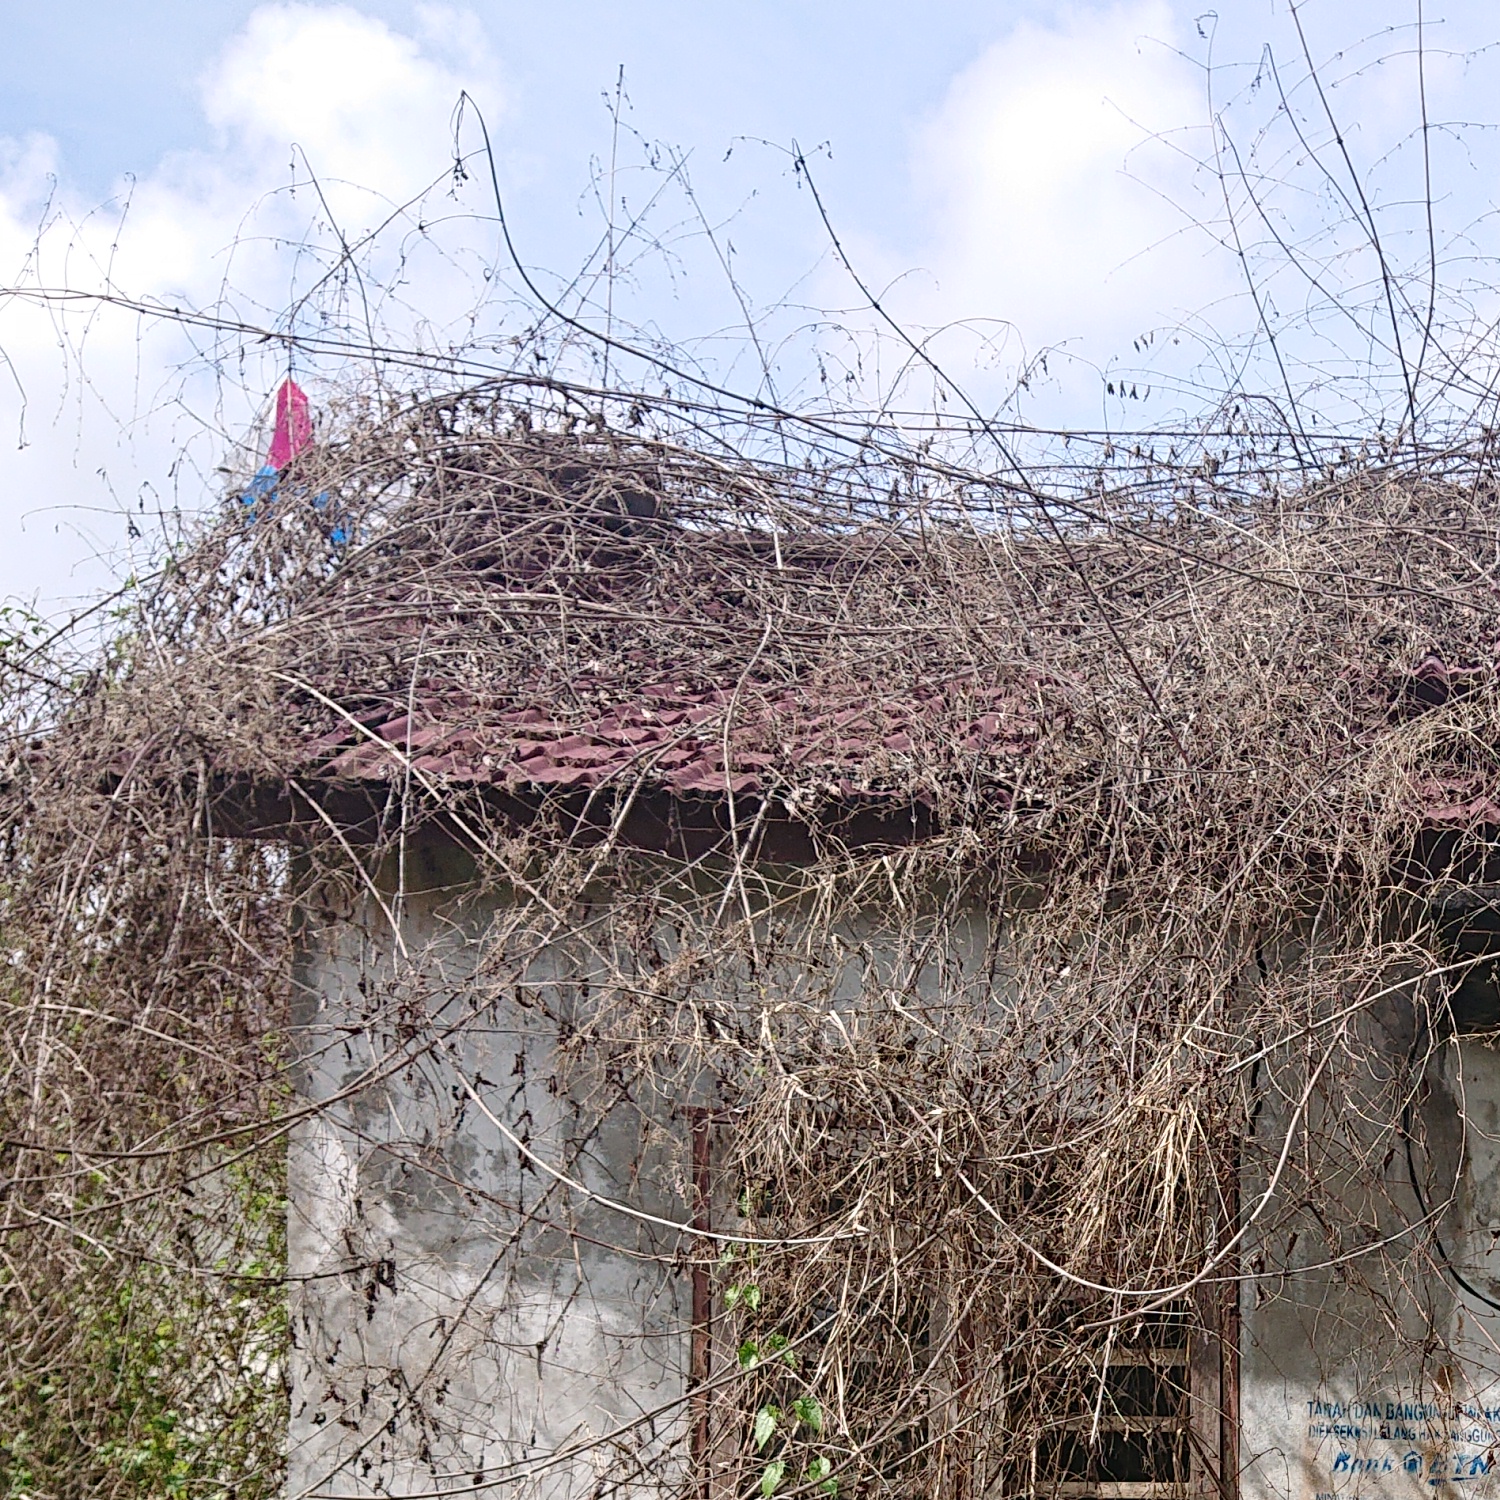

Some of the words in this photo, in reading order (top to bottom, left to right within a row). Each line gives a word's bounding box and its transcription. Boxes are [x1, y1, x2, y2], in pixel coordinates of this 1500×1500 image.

[1354, 1402, 1382, 1419] DAN
[1375, 1425, 1416, 1440] LLANG
[1332, 1451, 1395, 1473] Bank
